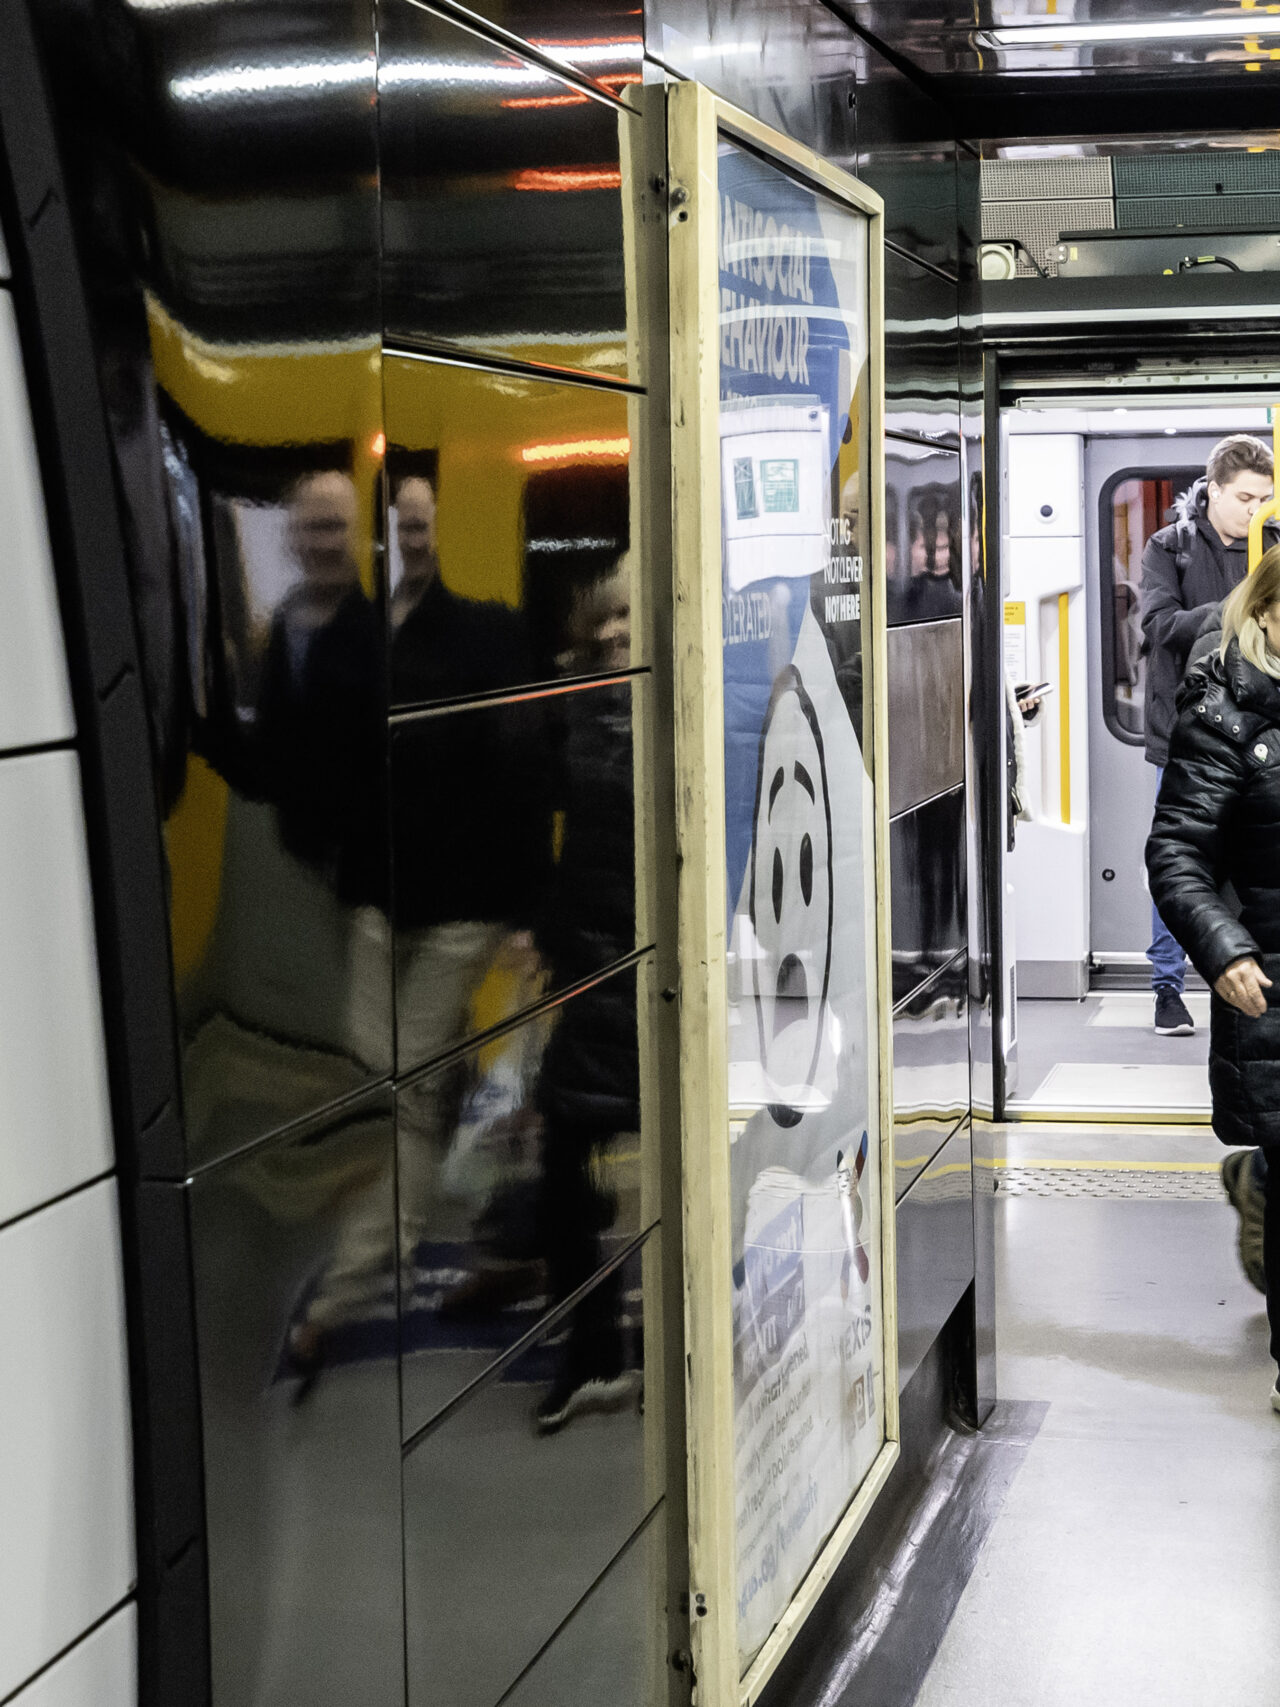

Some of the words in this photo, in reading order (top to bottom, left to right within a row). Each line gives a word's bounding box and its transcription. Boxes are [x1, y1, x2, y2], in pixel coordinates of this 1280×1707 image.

[721, 287, 809, 386] EHAVIOUR
[824, 557, 839, 584] NOT
[840, 556, 863, 582] CLEVER
[825, 596, 839, 623] NOT
[840, 594, 861, 621] HERE
